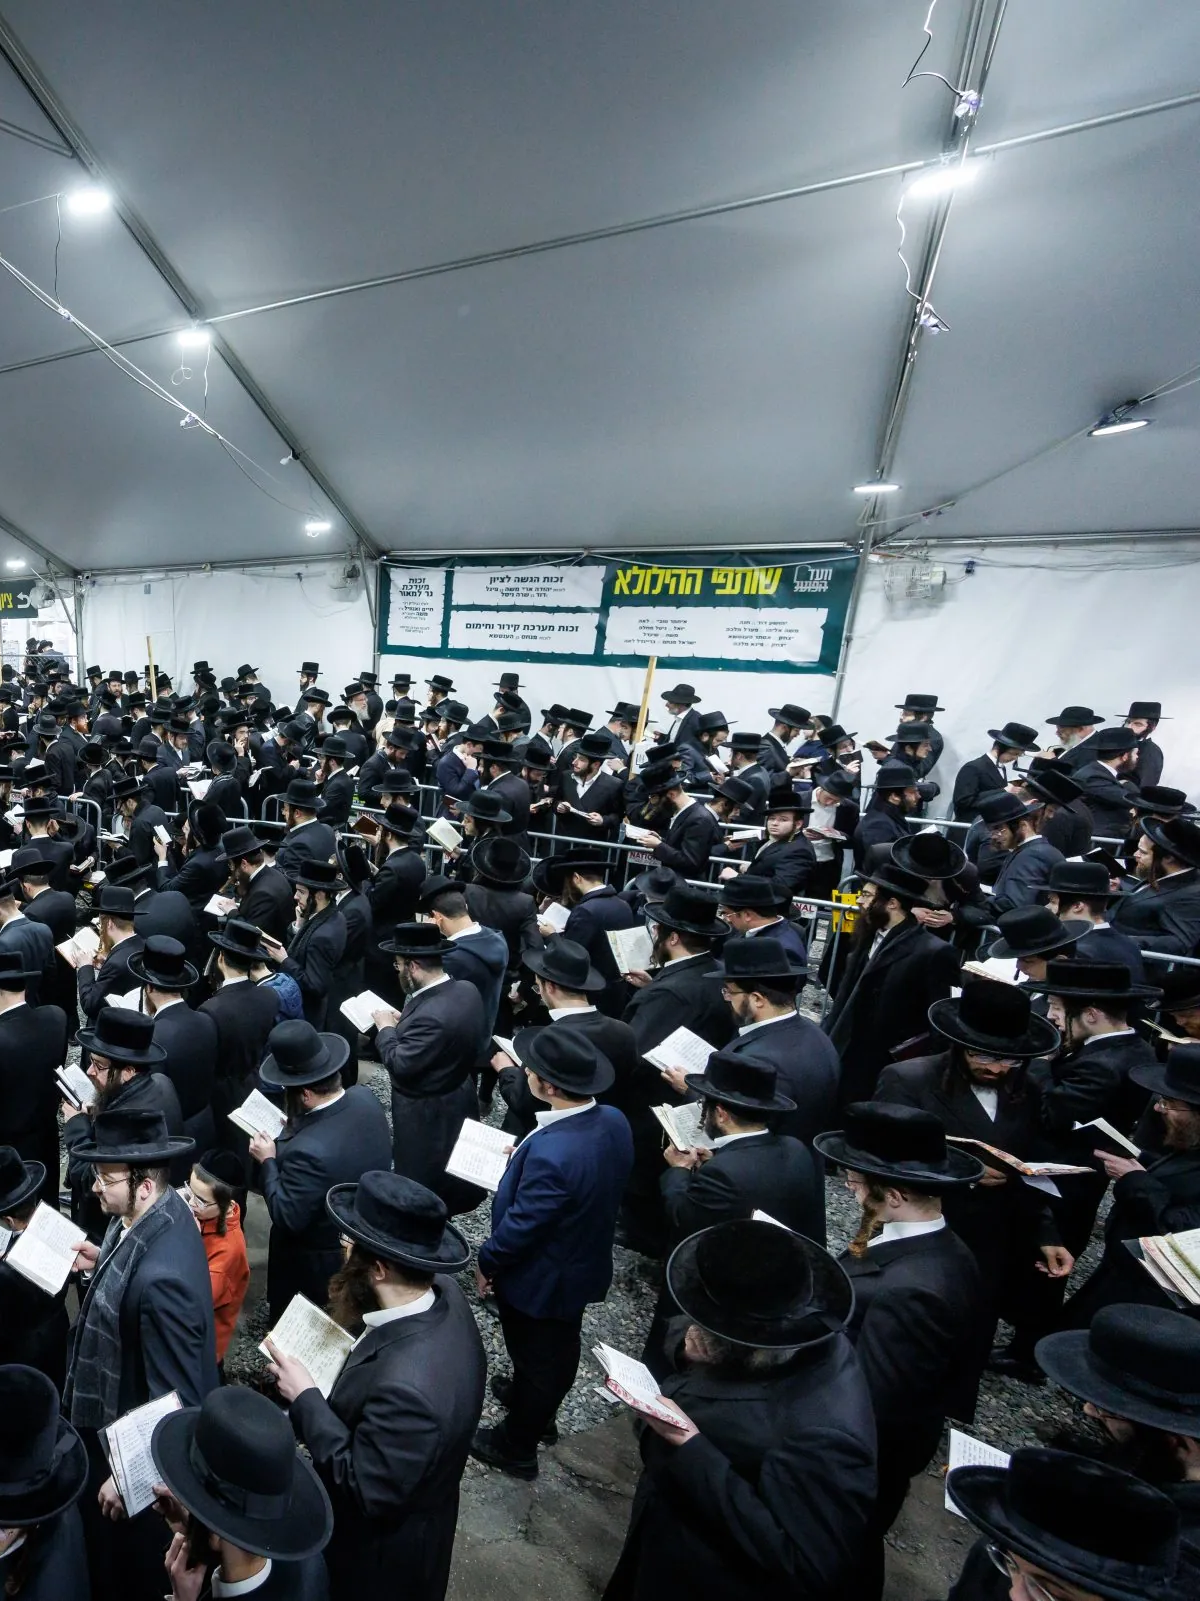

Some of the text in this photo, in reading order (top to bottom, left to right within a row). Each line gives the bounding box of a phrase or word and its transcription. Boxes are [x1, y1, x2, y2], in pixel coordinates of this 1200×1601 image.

[490, 574, 511, 584] לציון
[808, 569, 832, 580] וועד
[614, 566, 783, 595] שותפי ההילולא
[497, 623, 520, 632] קירור
